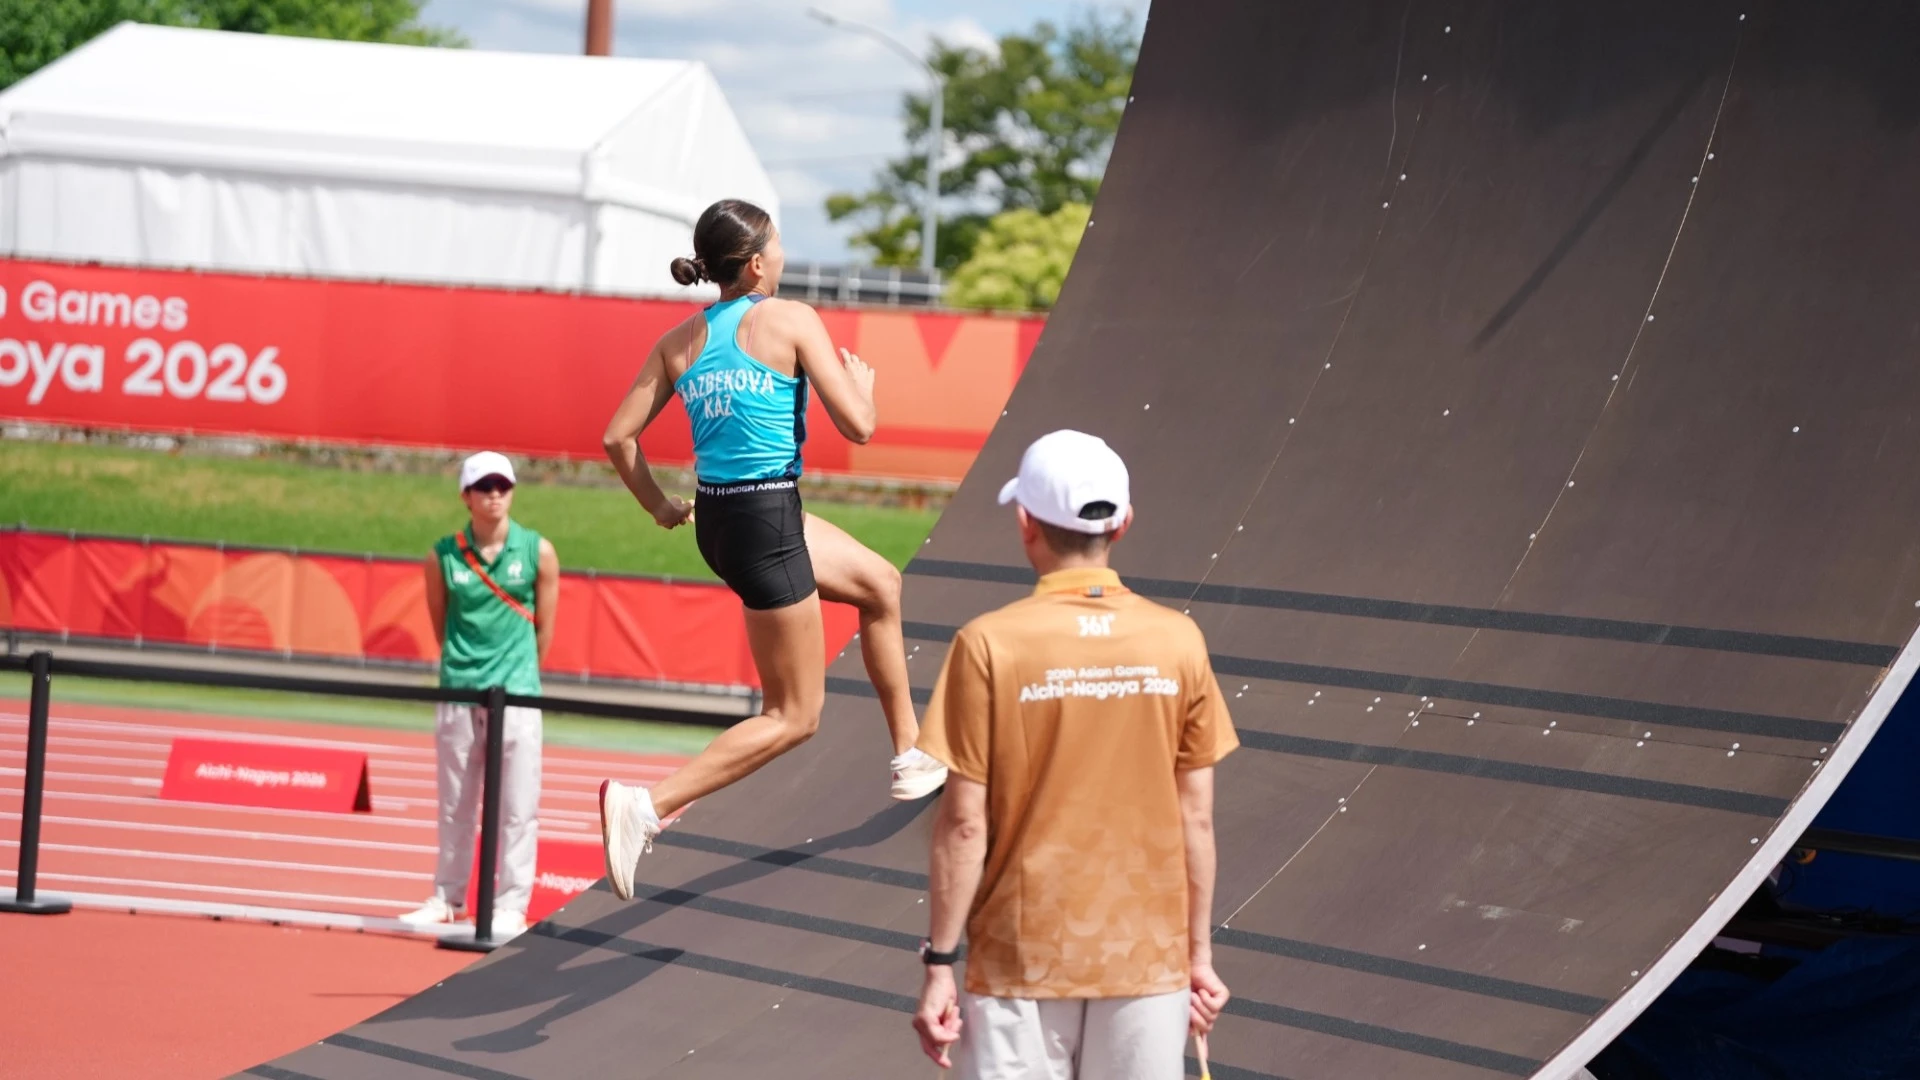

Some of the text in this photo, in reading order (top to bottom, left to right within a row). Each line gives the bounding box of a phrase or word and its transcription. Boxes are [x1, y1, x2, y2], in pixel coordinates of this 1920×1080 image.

[21, 280, 189, 331] Games
[122, 338, 287, 404] 2026
[677, 368, 775, 405] KAZBEKOVA
[704, 394, 733, 419] KAZ
[1077, 666, 1113, 679] Asian
[1114, 664, 1159, 678] Games
[1020, 677, 1179, 702] Aichi-Nagoya 2026
